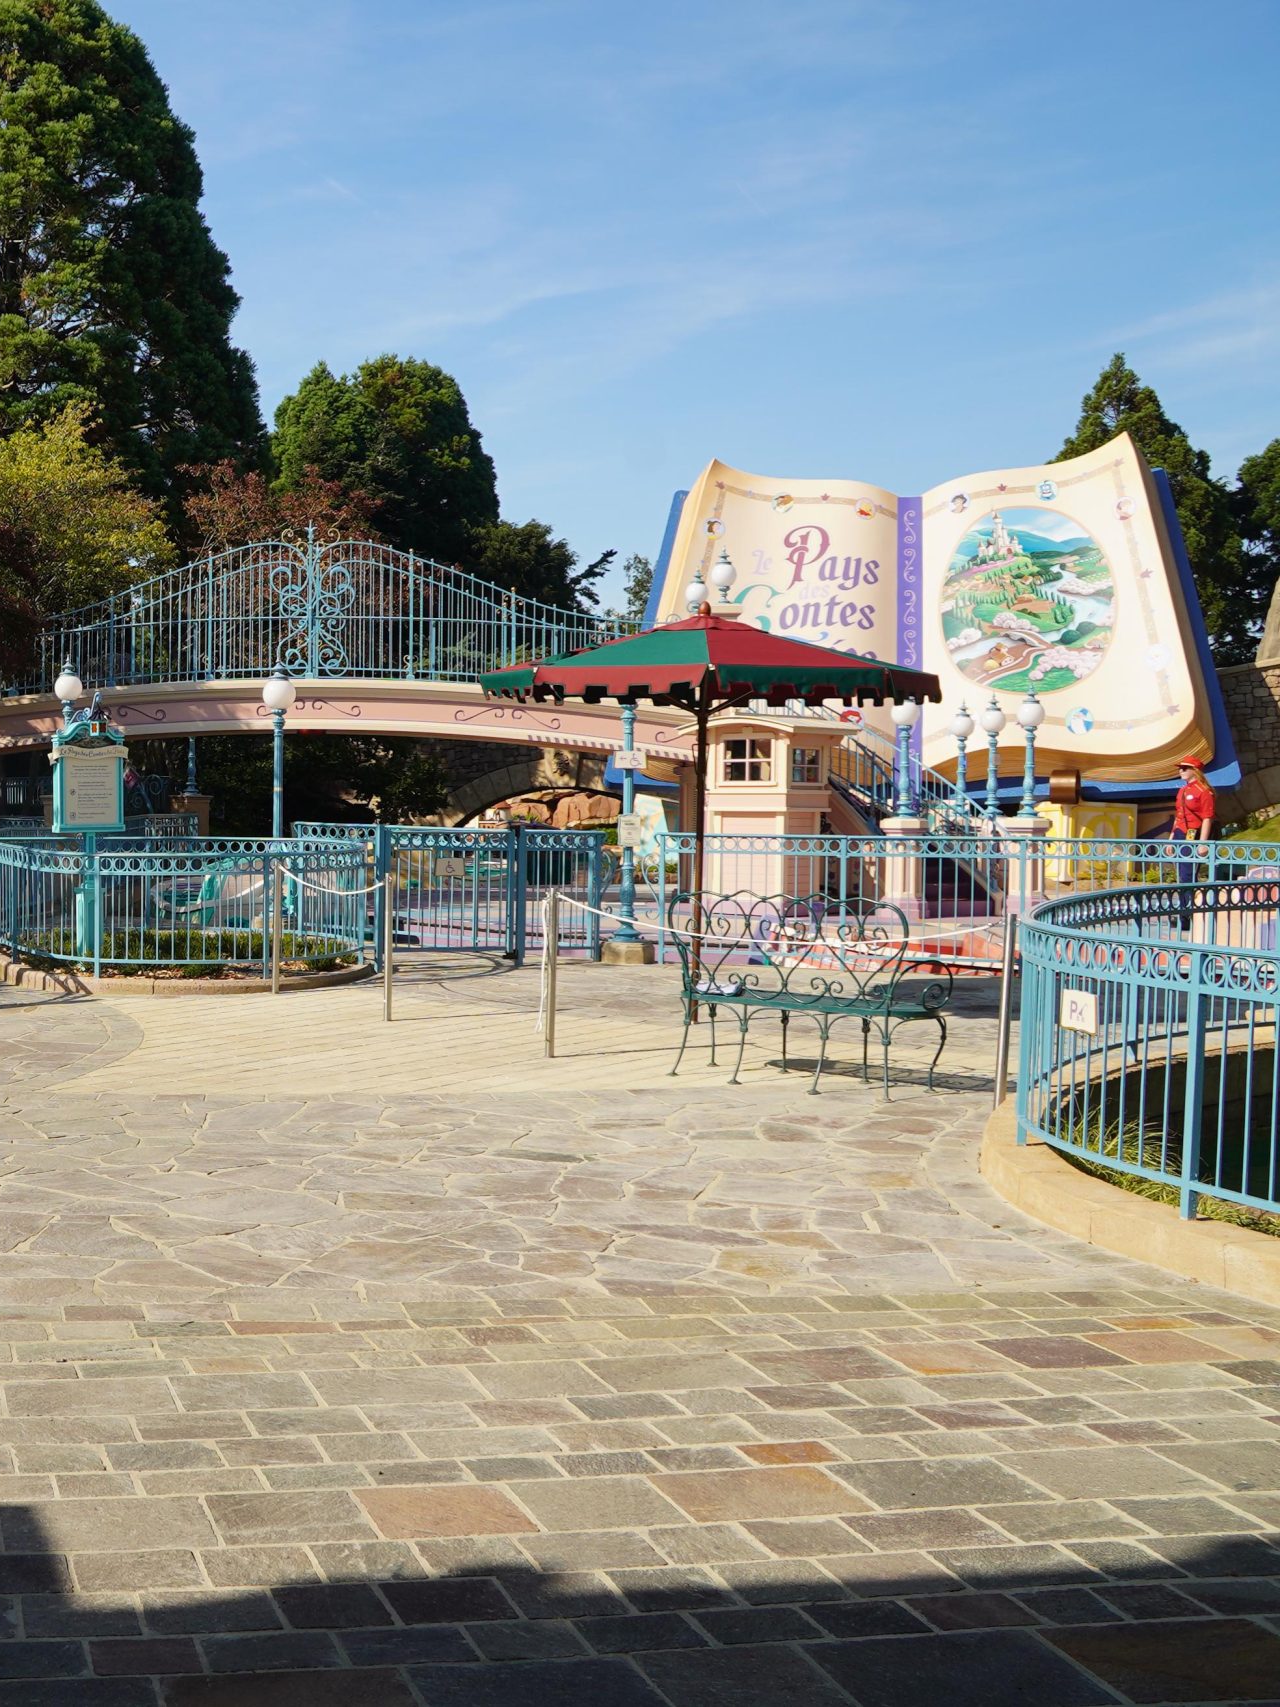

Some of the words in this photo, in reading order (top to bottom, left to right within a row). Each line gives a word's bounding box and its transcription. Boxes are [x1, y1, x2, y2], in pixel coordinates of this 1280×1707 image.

[752, 549, 773, 575] Le
[784, 525, 880, 591] Pays
[799, 582, 830, 600] des
[1070, 1000, 1078, 1020] P
